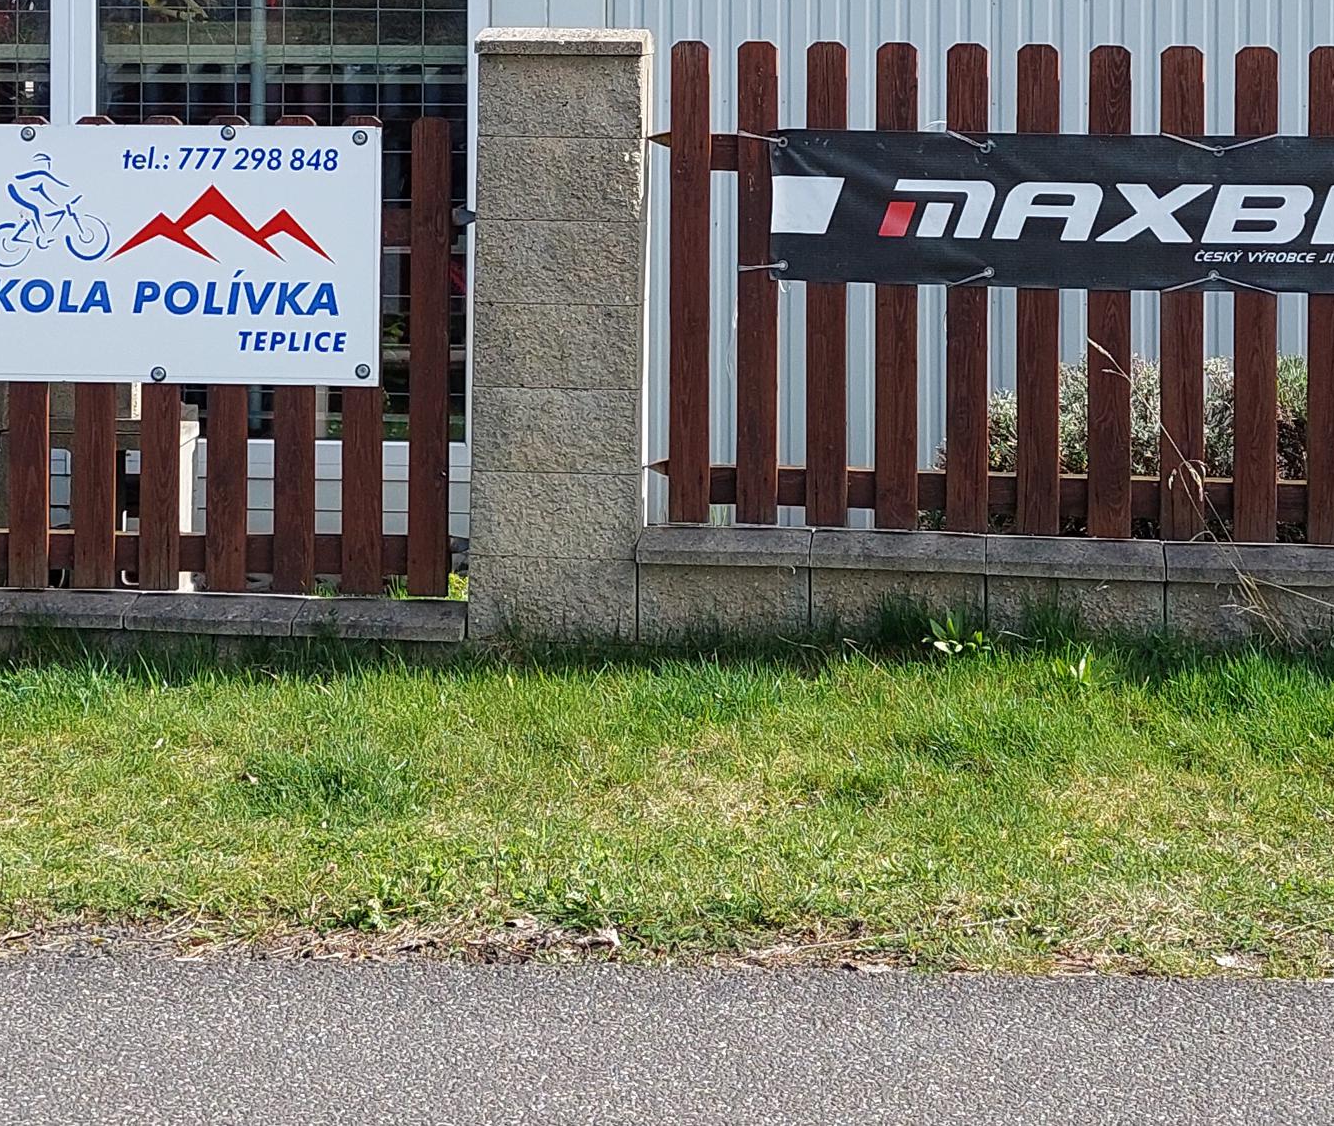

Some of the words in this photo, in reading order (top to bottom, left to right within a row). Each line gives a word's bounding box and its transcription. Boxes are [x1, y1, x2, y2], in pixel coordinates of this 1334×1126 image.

[122, 145, 170, 172] tel.:
[178, 147, 227, 171] 777
[233, 148, 282, 171] 298
[289, 148, 340, 172] 848
[1194, 249, 1243, 263] ČESKÝ
[1248, 249, 1317, 263] VÝROBCE
[132, 269, 340, 317] POLÍVKA
[238, 330, 348, 353] TEPLICE
